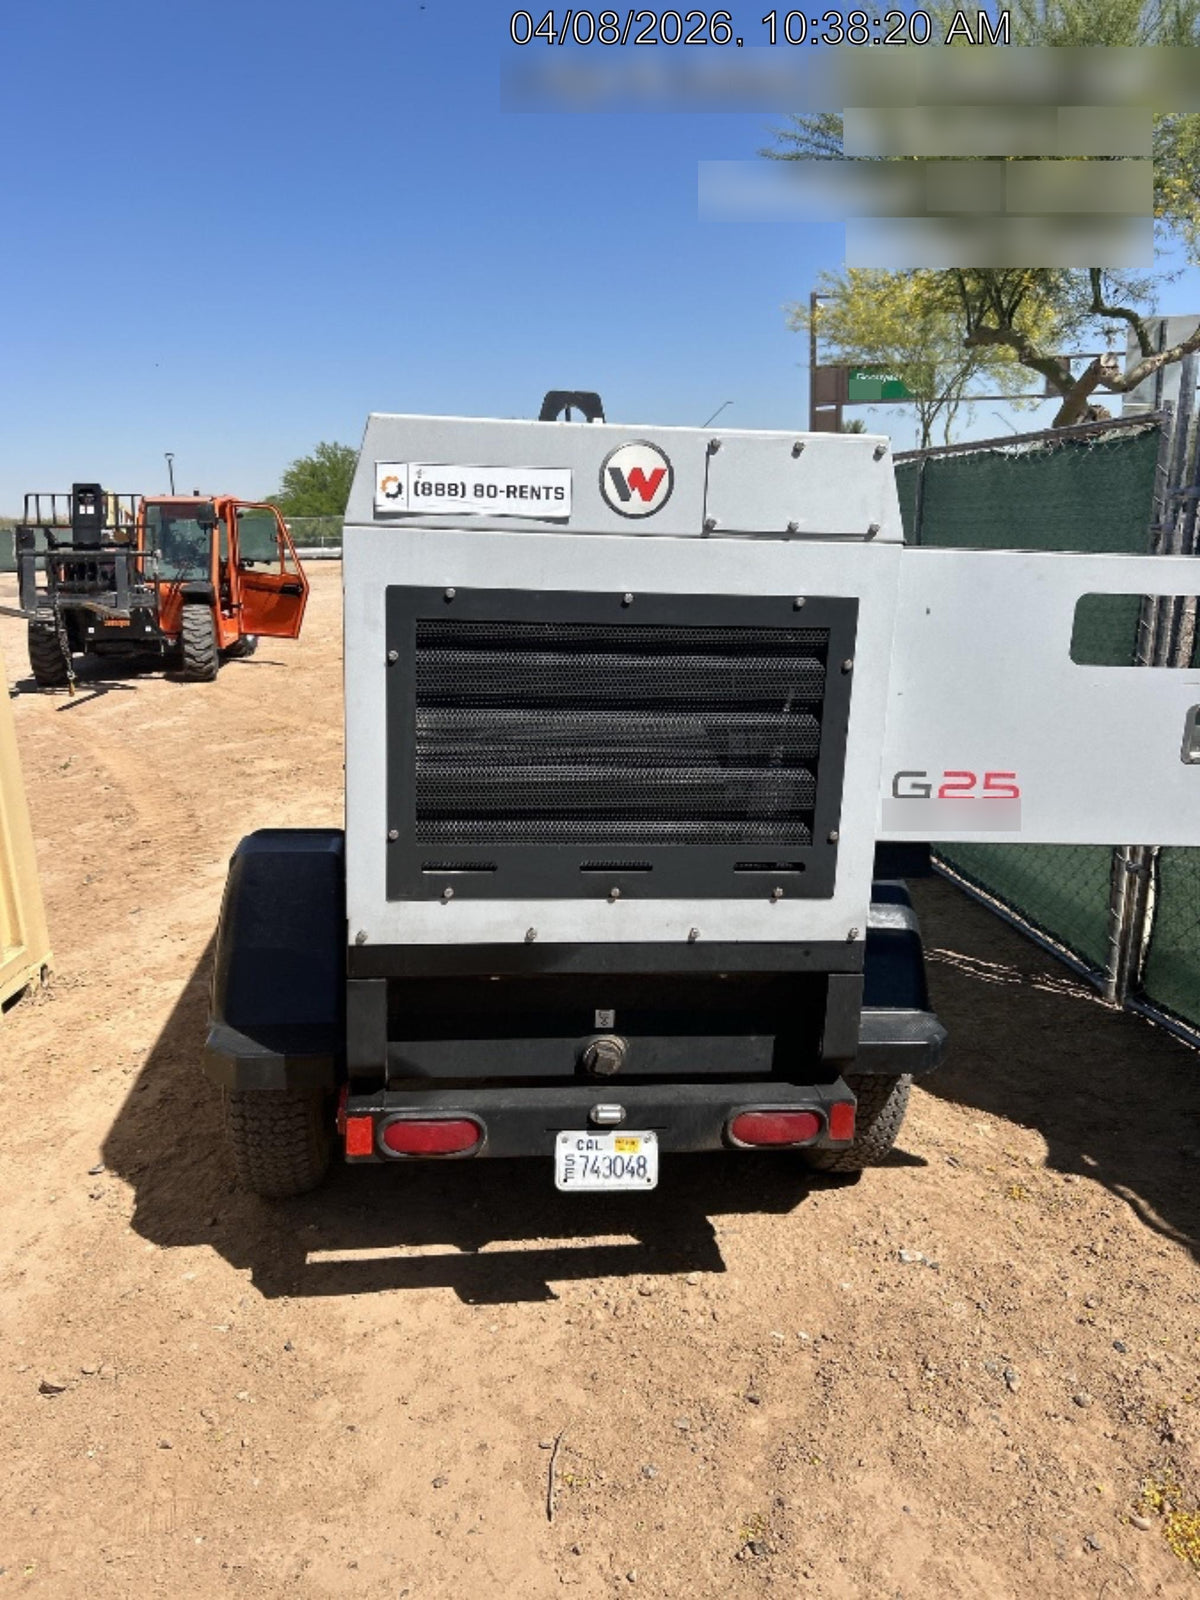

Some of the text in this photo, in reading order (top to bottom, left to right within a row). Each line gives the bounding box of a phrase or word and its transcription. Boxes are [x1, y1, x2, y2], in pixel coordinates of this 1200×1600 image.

[413, 480, 565, 501] (888) 80-RENTS
[892, 770, 1020, 799] G25
[577, 1139, 603, 1151] CAL
[579, 1155, 647, 1178] 743048
